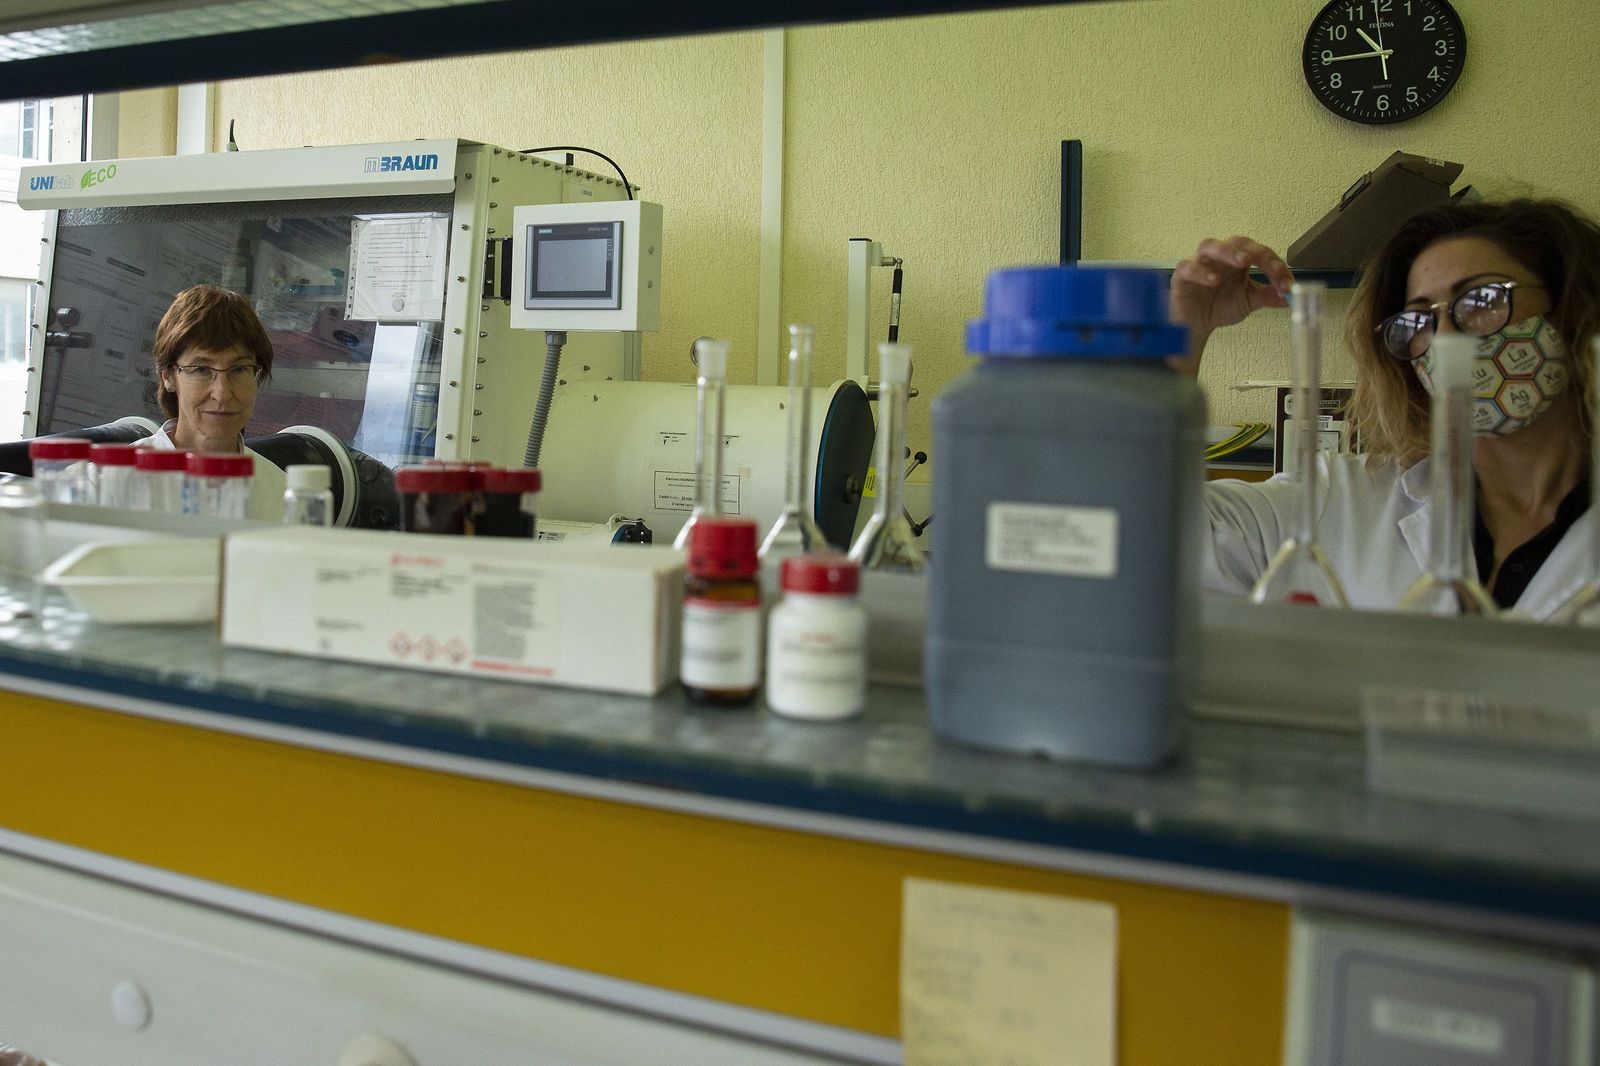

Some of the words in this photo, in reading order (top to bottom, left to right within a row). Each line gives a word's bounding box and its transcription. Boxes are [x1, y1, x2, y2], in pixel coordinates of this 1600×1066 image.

[1346, 5, 1363, 21] 11
[1403, 1, 1412, 16] 1
[1422, 15, 1436, 32] 2
[1326, 24, 1347, 41] 10
[1434, 39, 1447, 56] 3
[1321, 49, 1333, 66] 9
[1330, 72, 1342, 89] 8
[1427, 66, 1440, 82] 4
[1351, 89, 1364, 106] 7
[1376, 94, 1390, 111] 6
[1405, 86, 1418, 103] 5
[86, 164, 117, 188] ECO
[1507, 348, 1528, 363] La
[1509, 389, 1531, 405] Ag
